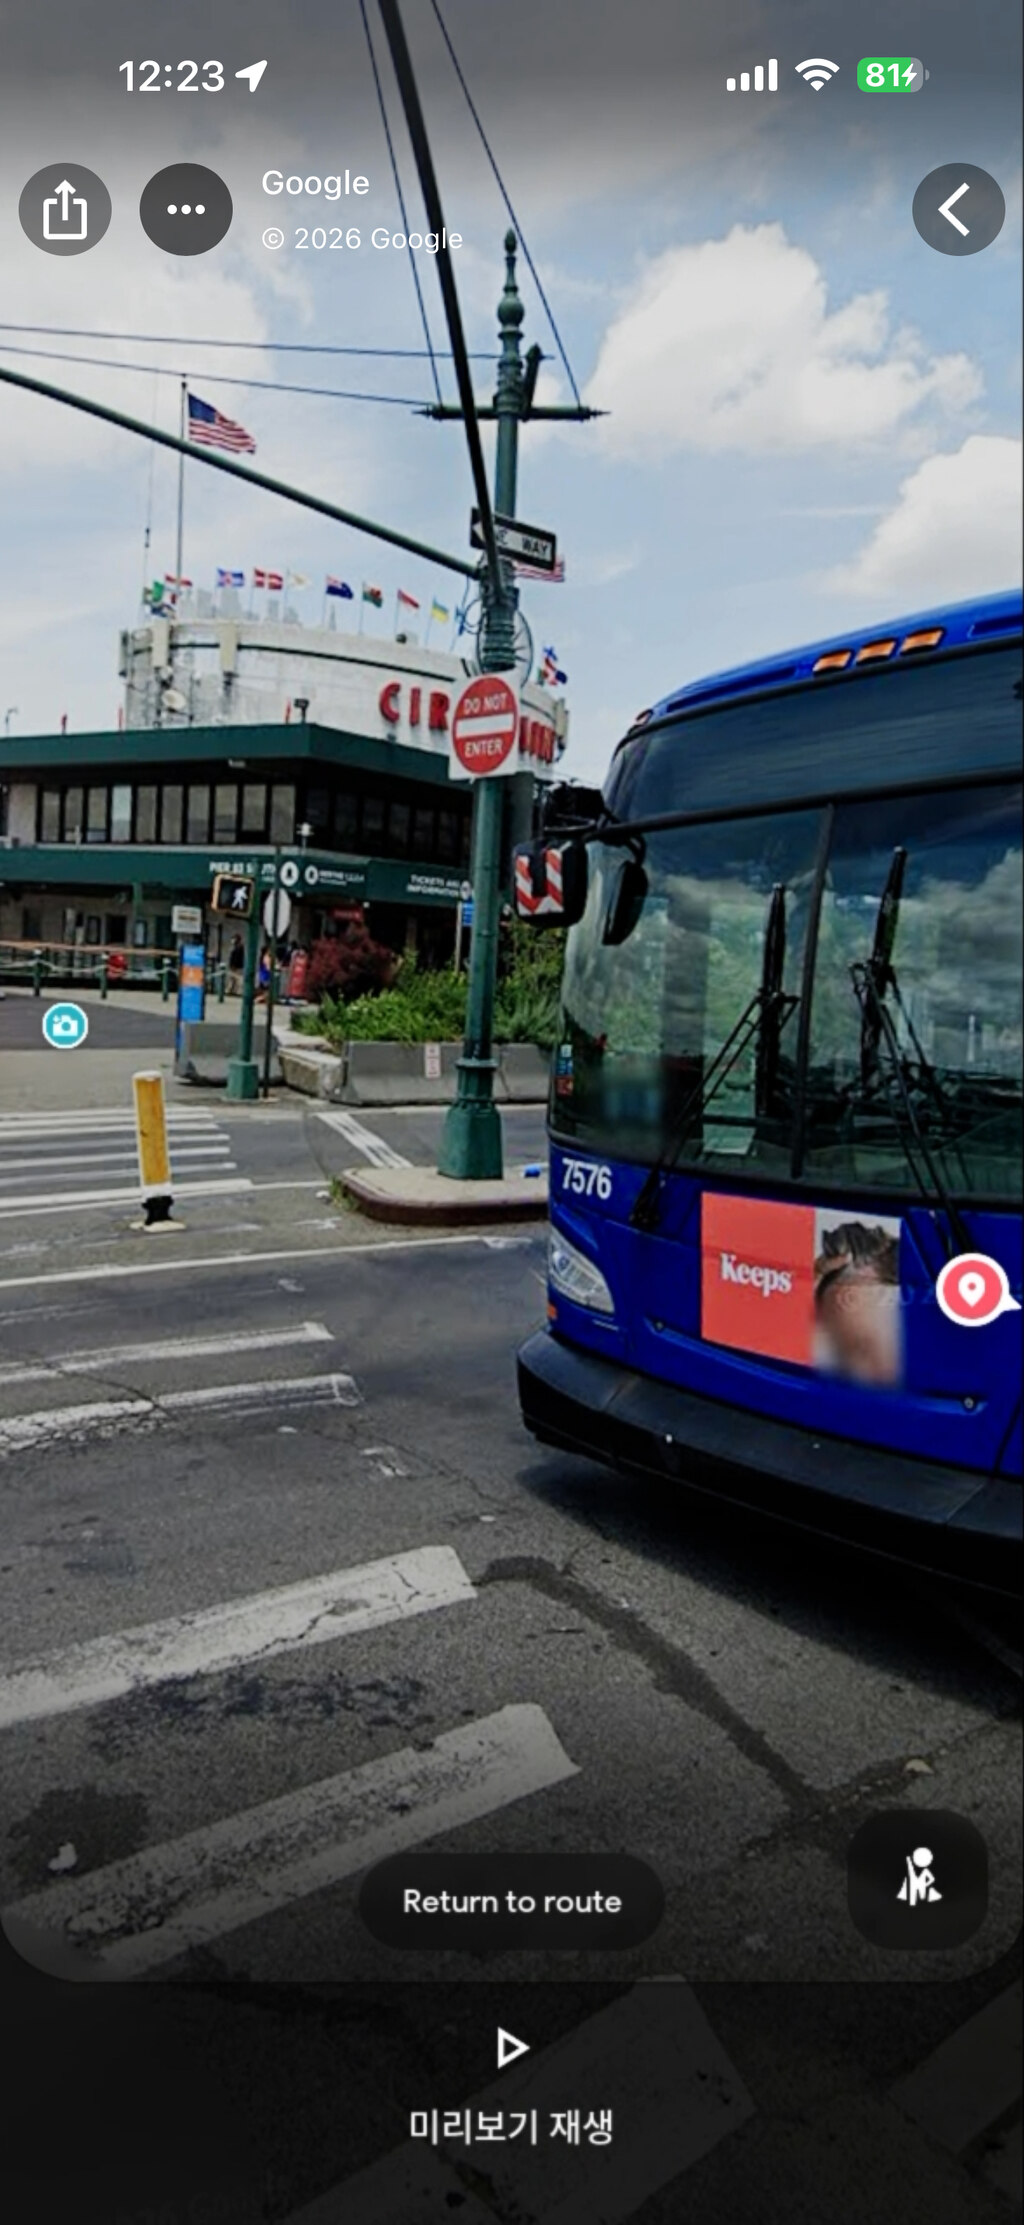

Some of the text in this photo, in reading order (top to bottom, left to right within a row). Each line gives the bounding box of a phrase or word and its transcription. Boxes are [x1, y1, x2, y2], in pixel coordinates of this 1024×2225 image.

[522, 537, 548, 555] WAY
[463, 693, 507, 715] DO NOT
[464, 738, 504, 758] ENTER
[561, 1158, 612, 1200] 7576
[720, 1252, 792, 1298] Keeps
